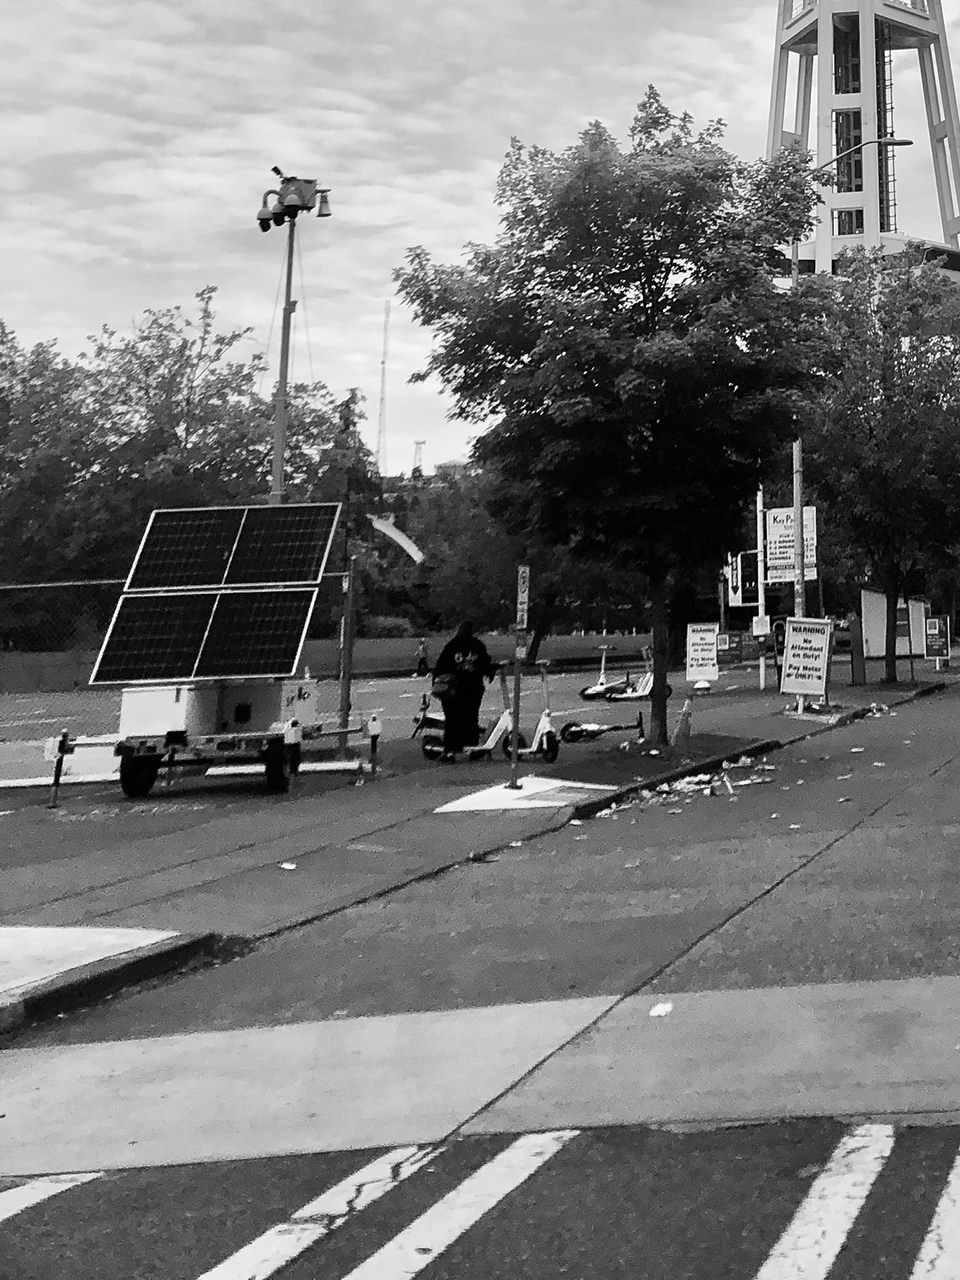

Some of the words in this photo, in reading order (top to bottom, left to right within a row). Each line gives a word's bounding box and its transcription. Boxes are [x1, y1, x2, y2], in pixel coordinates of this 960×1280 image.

[792, 626, 826, 635] WARNING
[790, 644, 824, 652] Attendant
[788, 664, 800, 673] Pay
